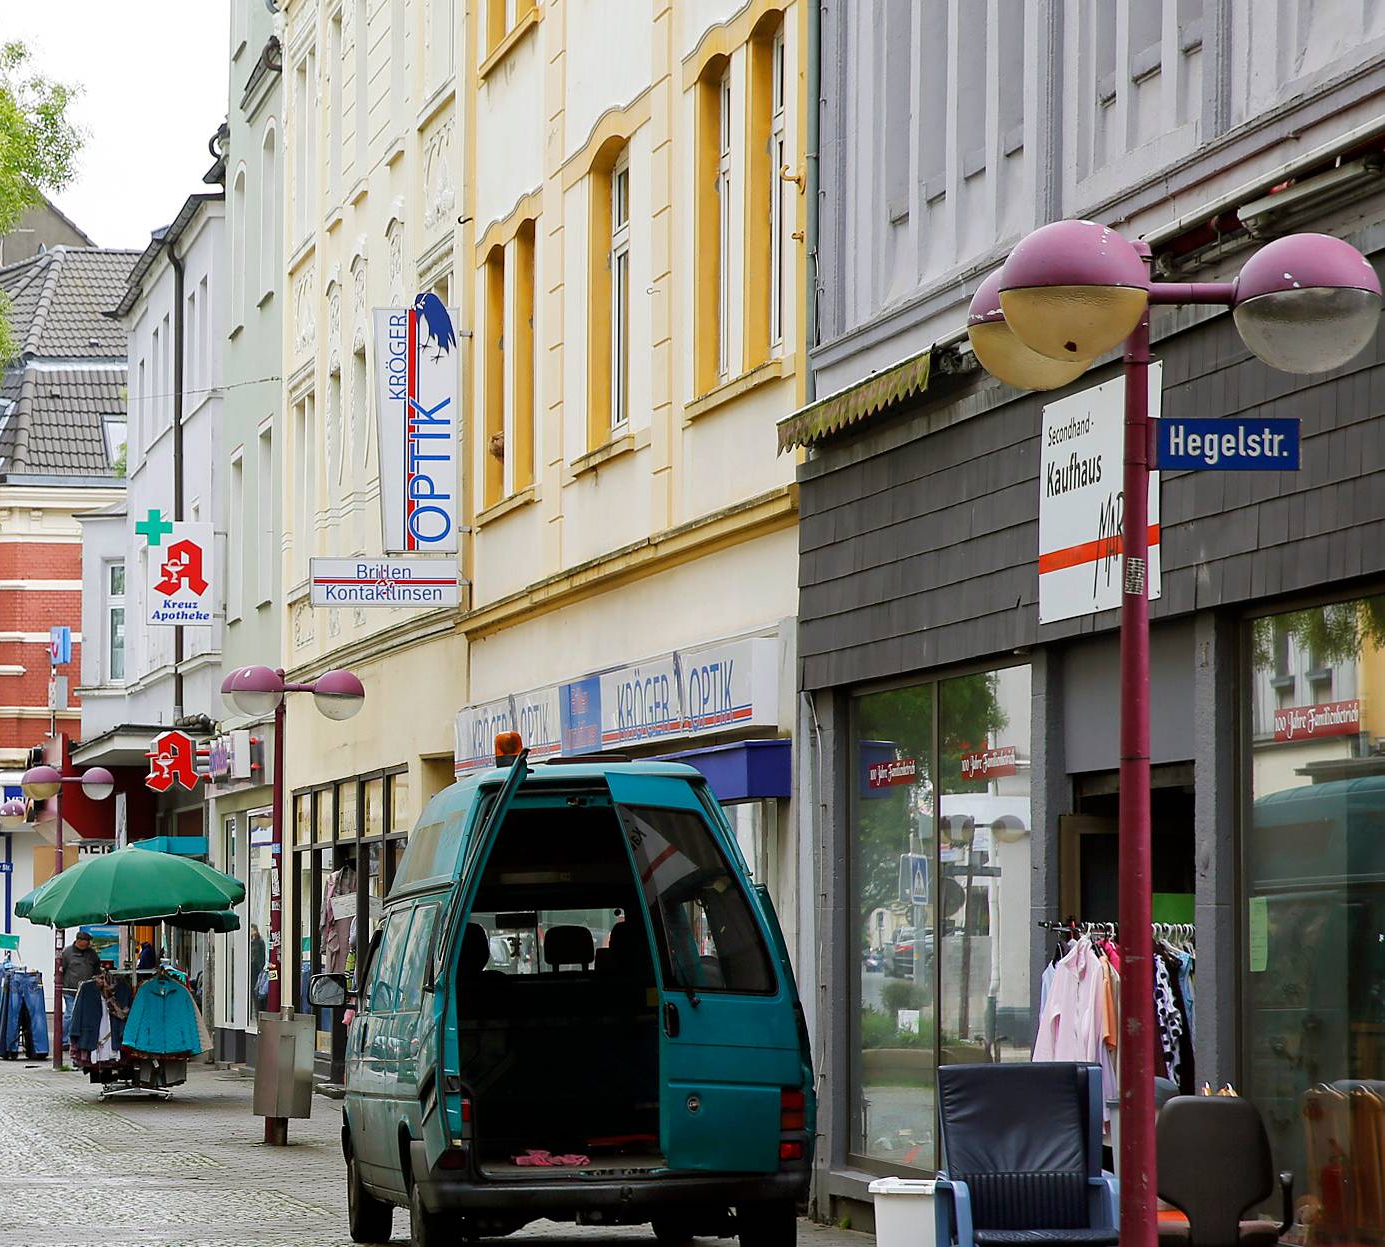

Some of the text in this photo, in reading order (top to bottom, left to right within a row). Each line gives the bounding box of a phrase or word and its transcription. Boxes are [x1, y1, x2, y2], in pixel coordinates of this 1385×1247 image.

[386, 315, 407, 400] KRÖGER
[1169, 425, 1289, 464] Hegelstr.
[409, 397, 451, 543] OPTIK
[1046, 453, 1102, 497] Kaufhaus
[356, 564, 412, 579] Brillen
[163, 600, 199, 609] Kreuz
[326, 585, 442, 600] Kontaktlinsen
[152, 610, 210, 621] Apotheke
[616, 659, 734, 743] KRÖGER OPTIK
[520, 702, 550, 760] OPTIK
